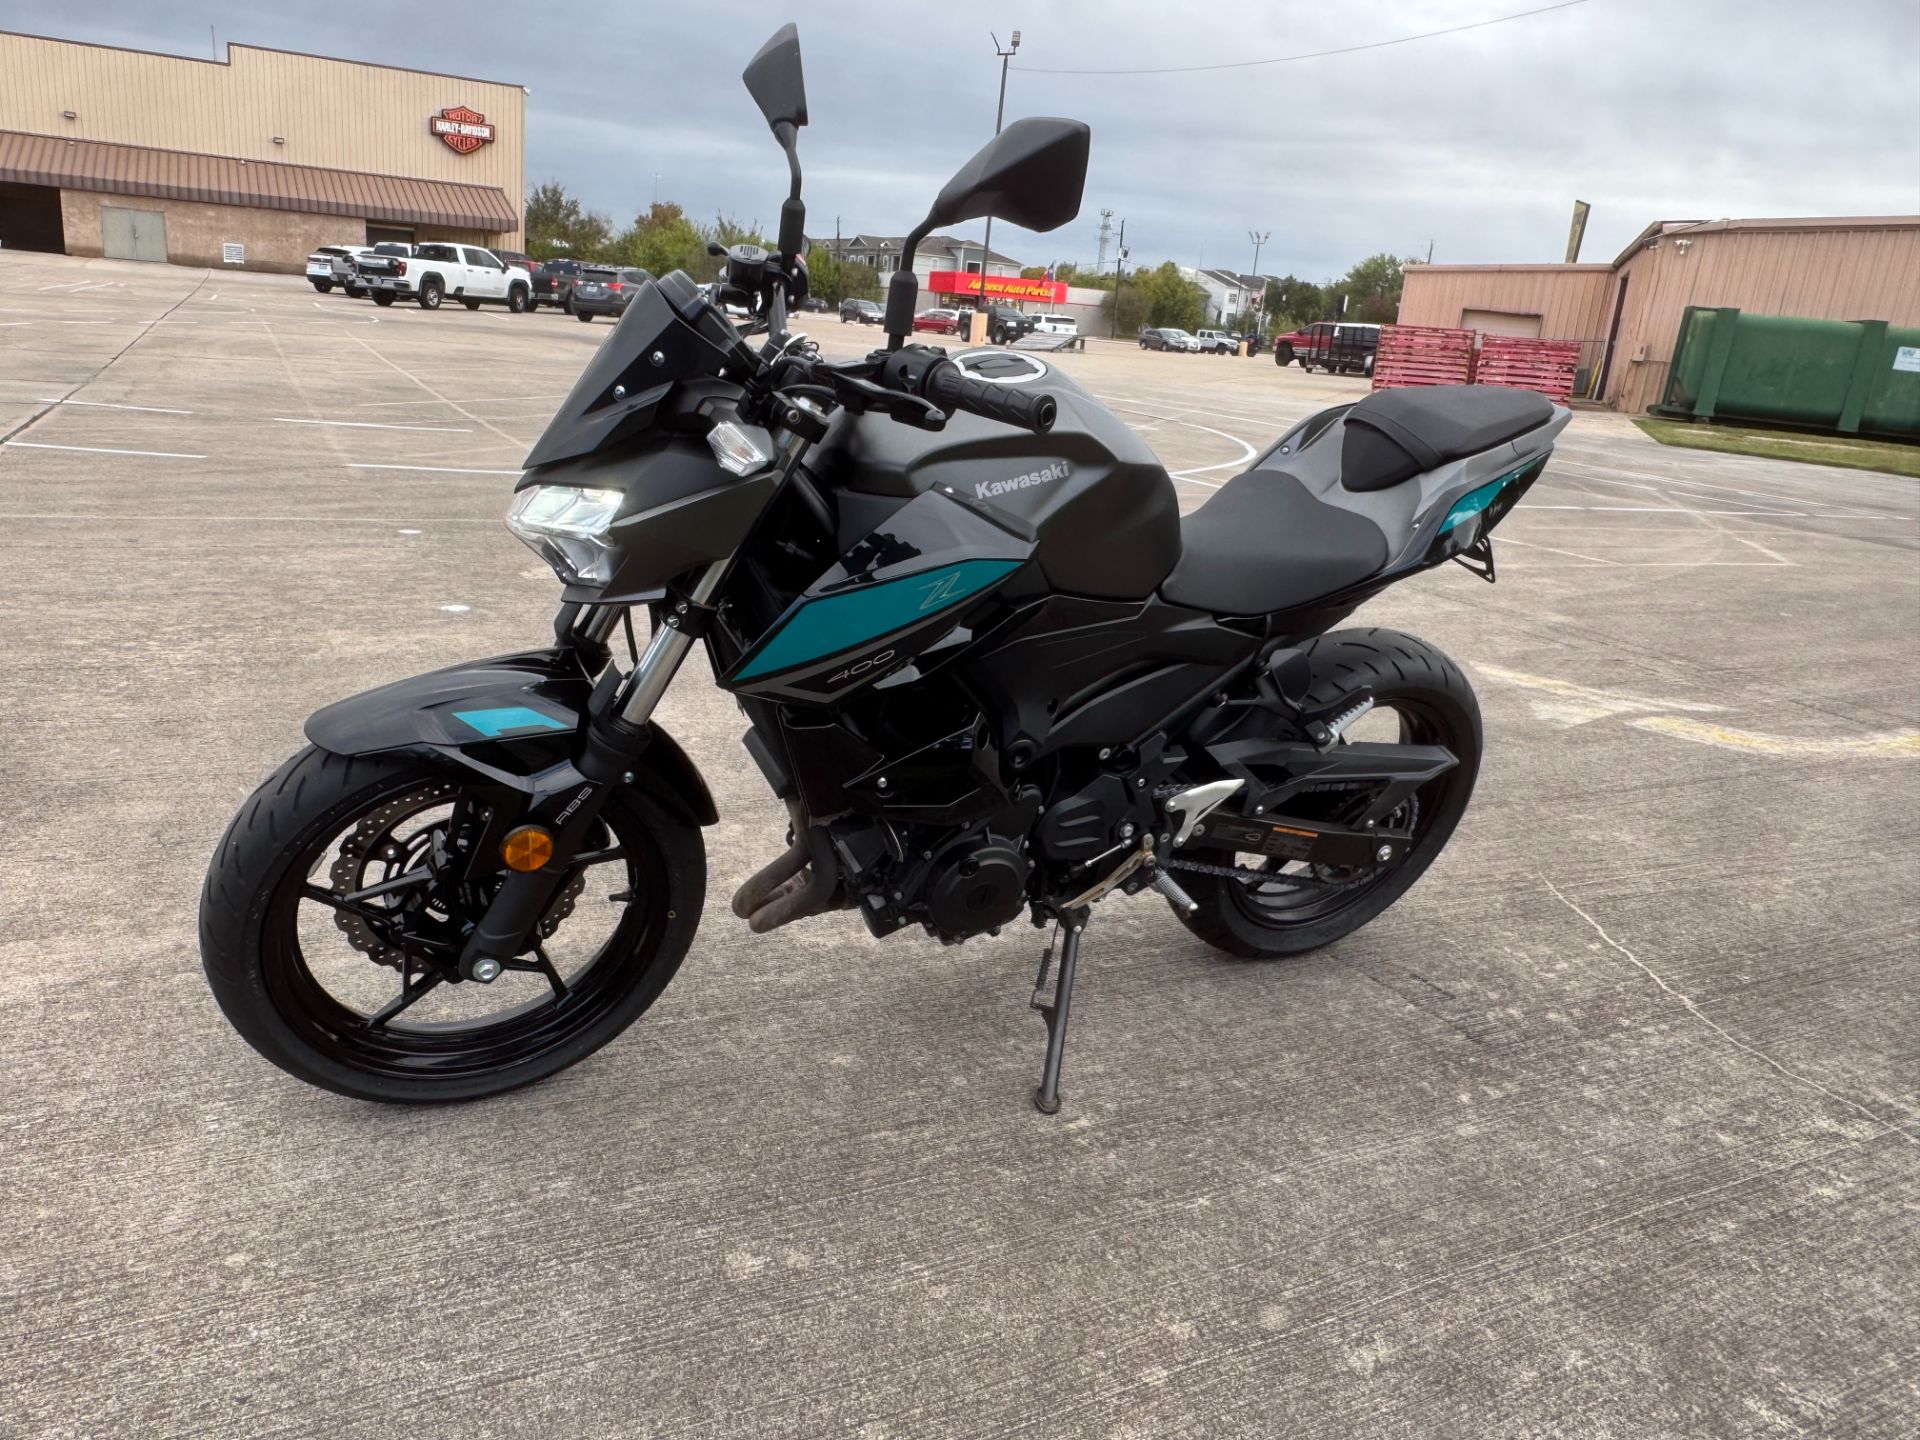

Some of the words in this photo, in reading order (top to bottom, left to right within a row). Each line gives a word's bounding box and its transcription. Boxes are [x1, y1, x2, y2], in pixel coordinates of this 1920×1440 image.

[449, 110, 478, 124] MOTOR
[435, 120, 491, 138] HARLEY-DAVIDSON
[447, 134, 478, 150] CYCLES
[968, 280, 1003, 292] Adance
[1004, 284, 1025, 294] Auto
[1026, 286, 1048, 297] Parts
[974, 460, 1070, 500] Kawasaki
[827, 649, 895, 683] 400
[555, 786, 592, 825] ABS
